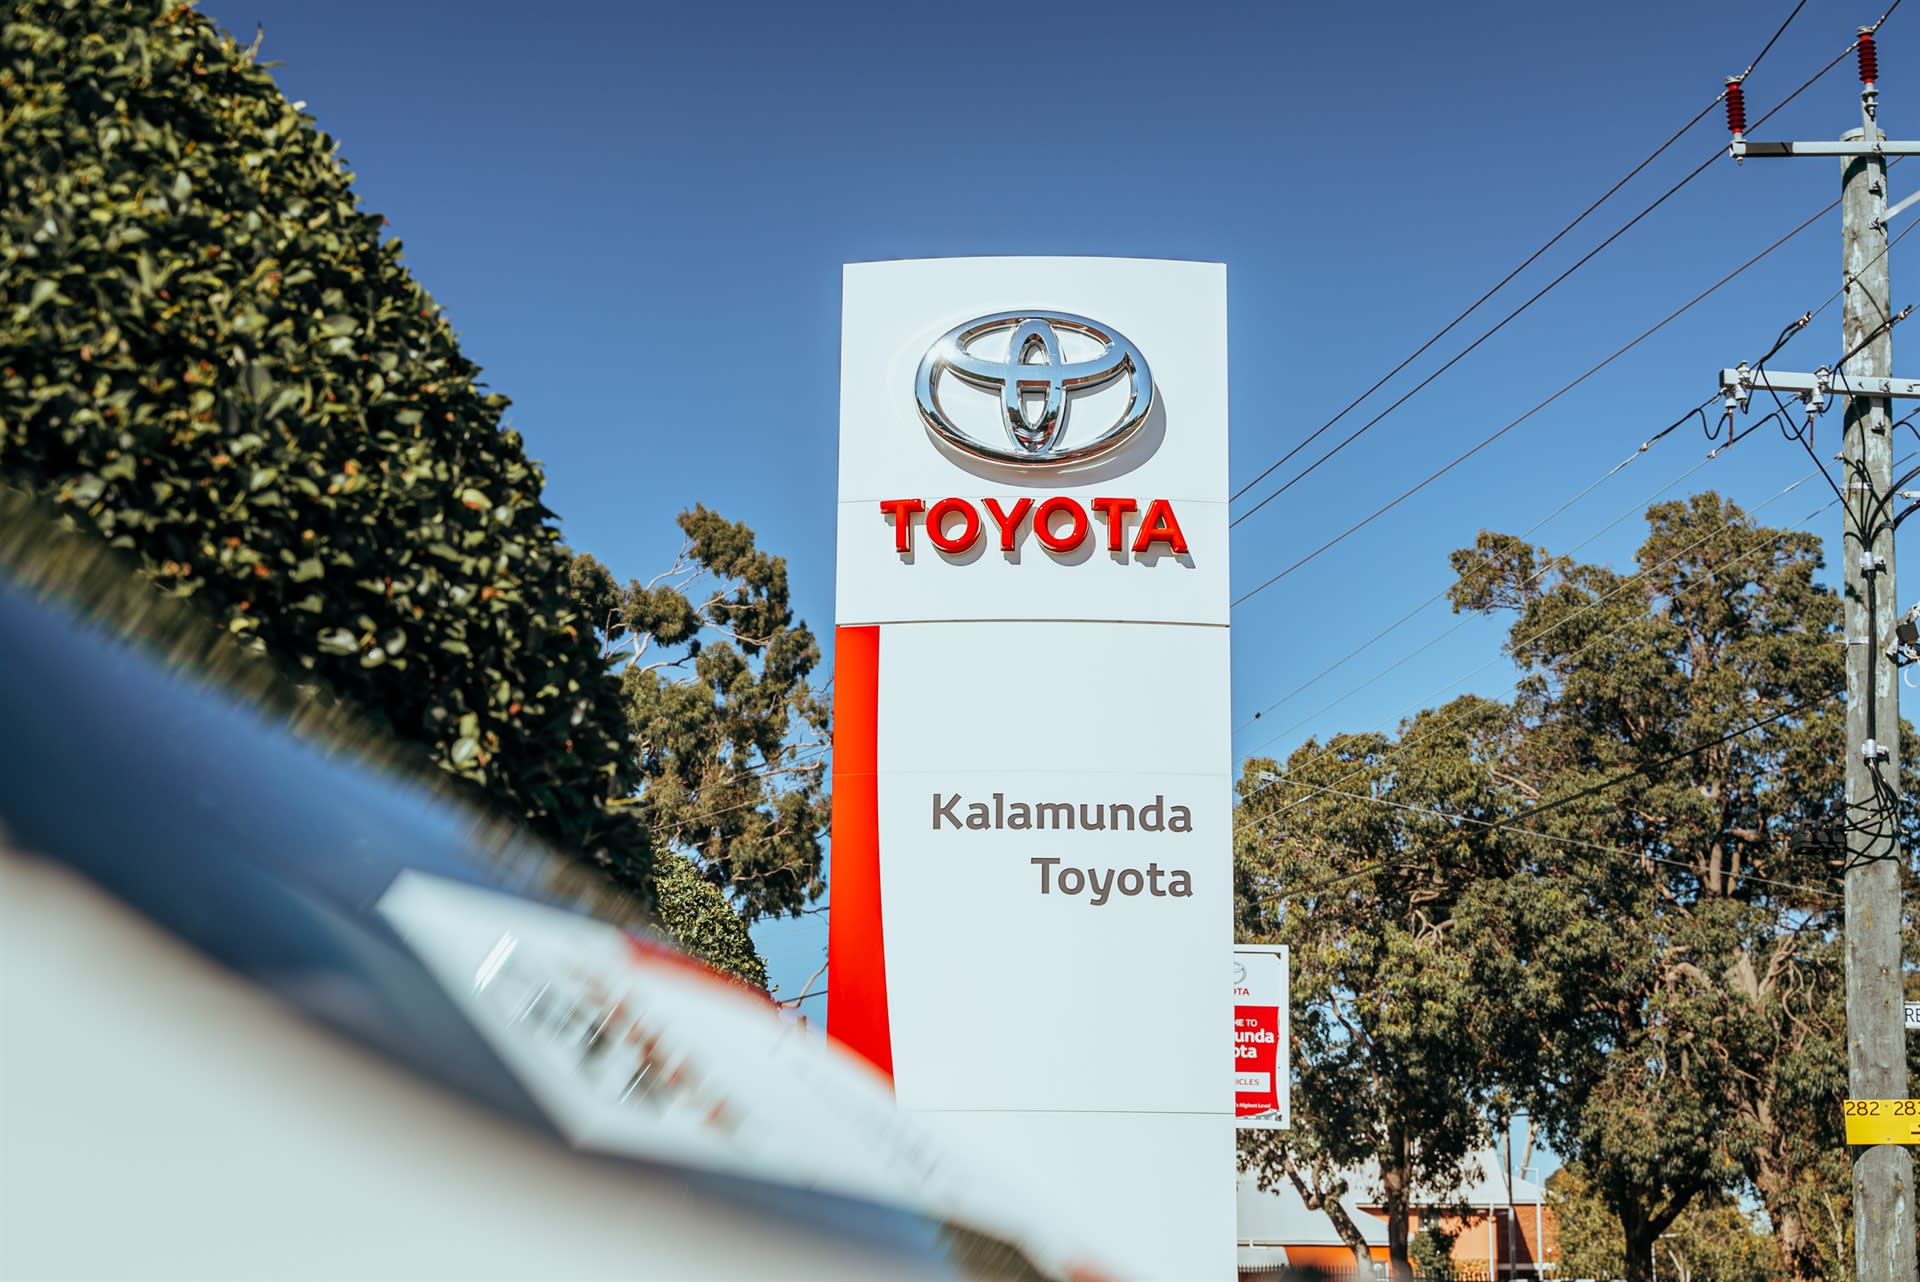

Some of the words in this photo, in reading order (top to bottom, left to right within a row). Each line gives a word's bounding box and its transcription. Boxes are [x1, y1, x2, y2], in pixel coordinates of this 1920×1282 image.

[880, 497, 1188, 553] TOYOTA
[932, 793, 1193, 832] Kalamunda
[1031, 857, 1193, 906] Toyota
[1245, 1018, 1258, 1027] TO
[1234, 1028, 1275, 1043] unda
[1235, 1078, 1260, 1086] ICLES
[1846, 1101, 1880, 1116] 282
[1894, 1101, 1920, 1116] 28
